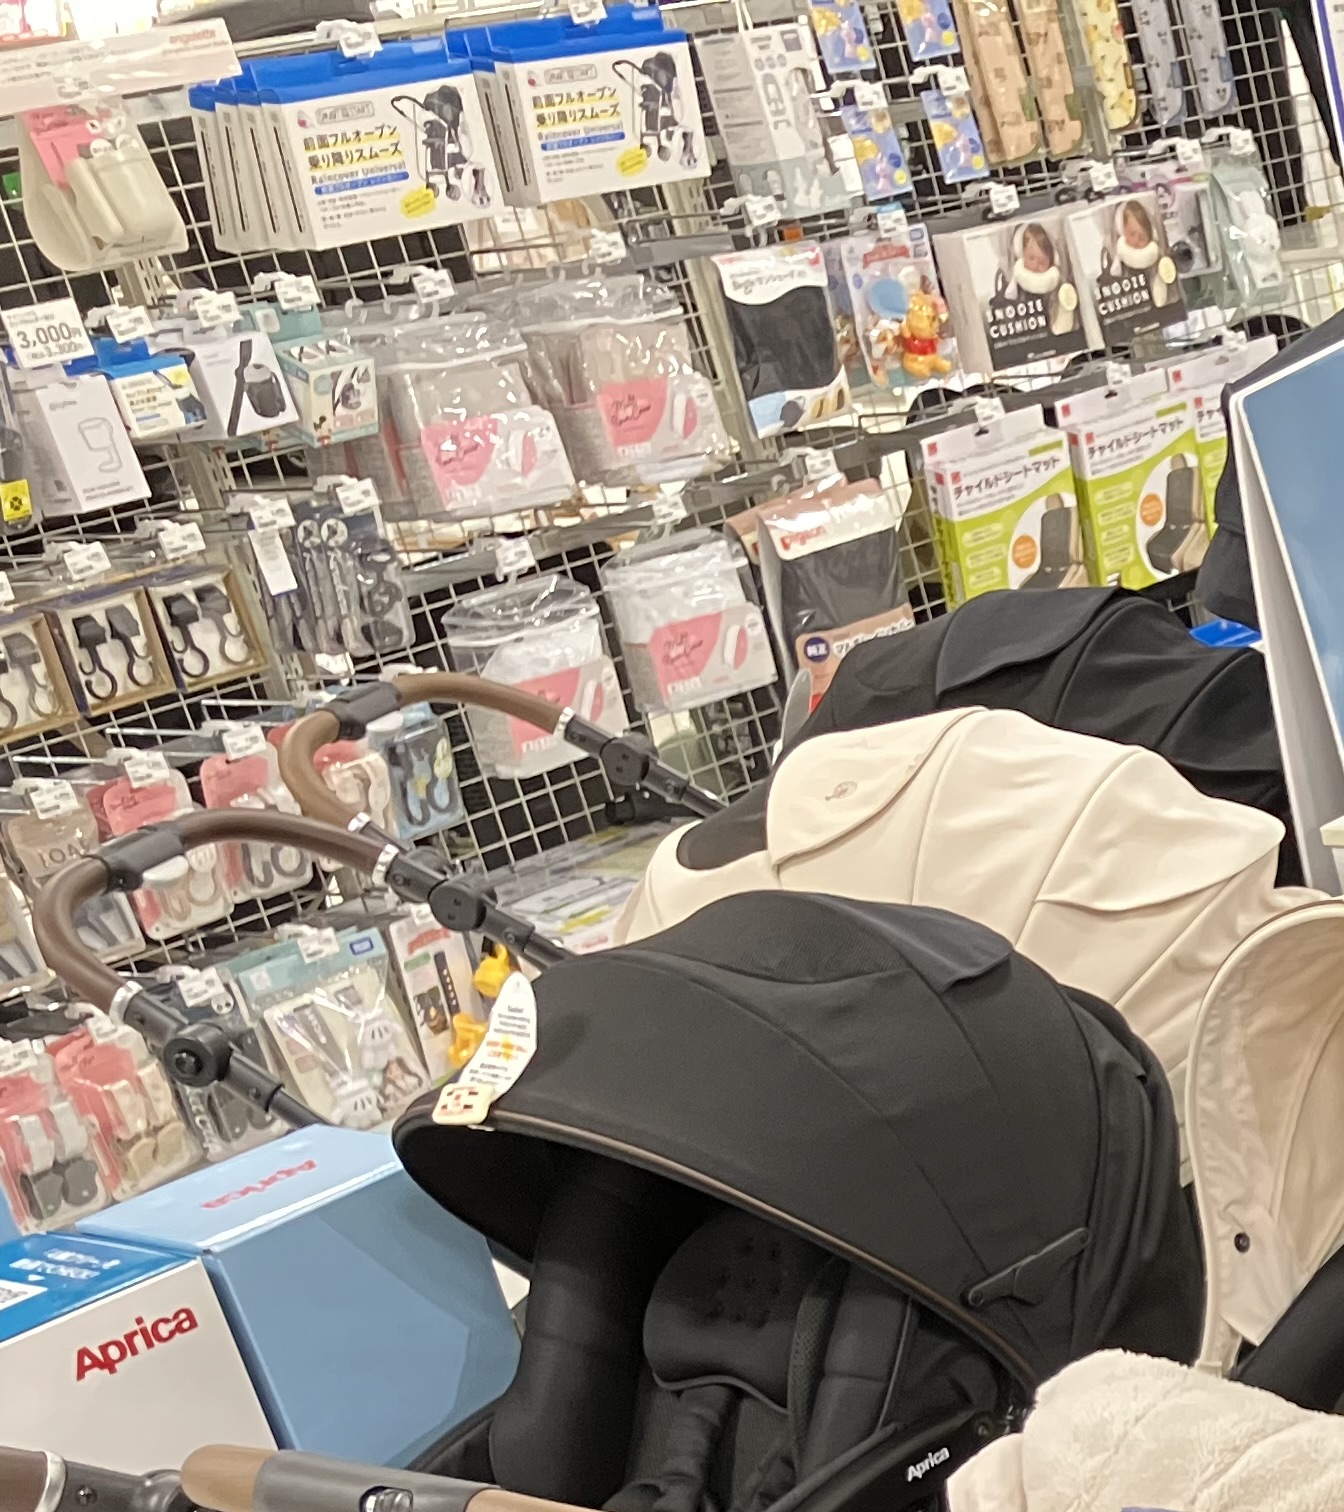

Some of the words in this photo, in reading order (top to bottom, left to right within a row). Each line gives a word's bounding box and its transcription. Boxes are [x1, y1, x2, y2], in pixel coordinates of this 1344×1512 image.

[303, 124, 397, 151] 前面フルオープン
[308, 140, 402, 168] 乗り降りスムーズ
[1098, 289, 1150, 316] CUSHION
[989, 315, 1047, 338] CUSHION
[1088, 416, 1184, 459] チャイルドシートマット
[953, 456, 1060, 499] チャイルドシートマット
[76, 1306, 200, 1382] Aprica
[907, 1447, 951, 1482] Aprica
